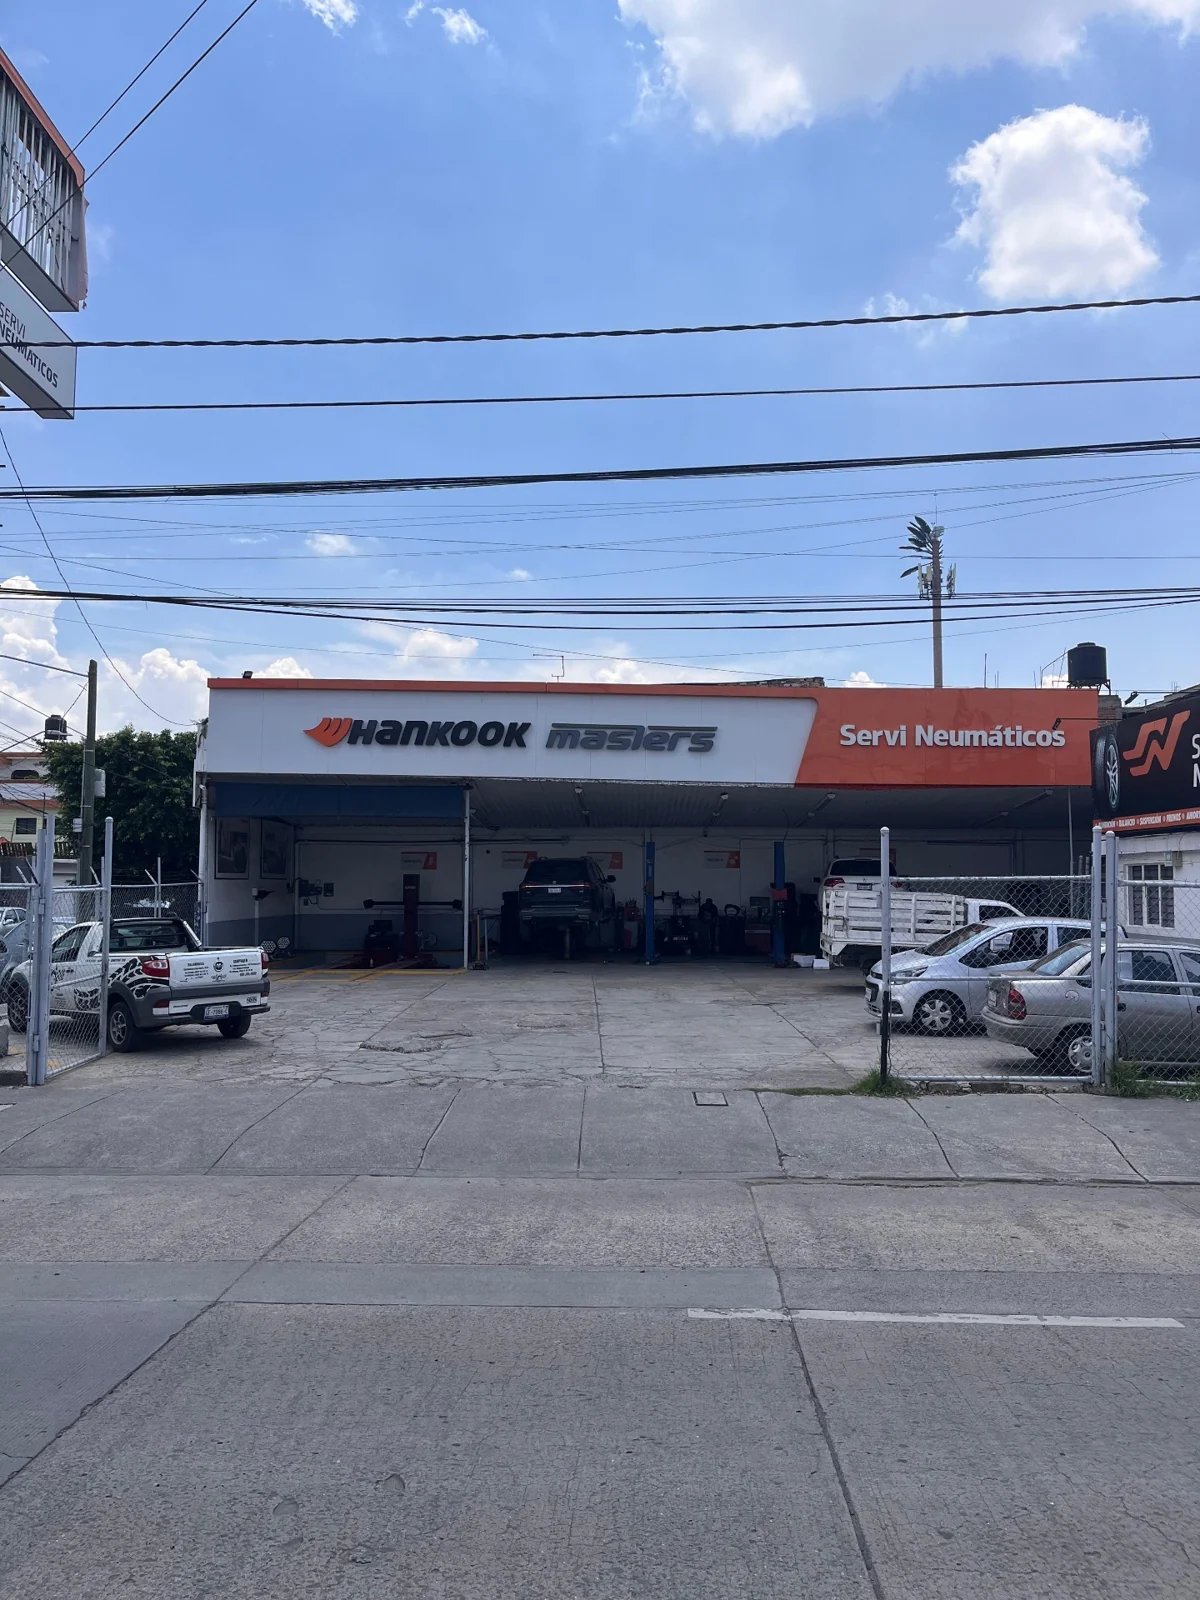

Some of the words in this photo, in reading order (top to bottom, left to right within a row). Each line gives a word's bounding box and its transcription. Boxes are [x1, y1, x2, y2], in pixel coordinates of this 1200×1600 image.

[0, 302, 26, 339] SERVI
[840, 725, 906, 746] Servi
[915, 725, 1065, 747] Neumáticos
